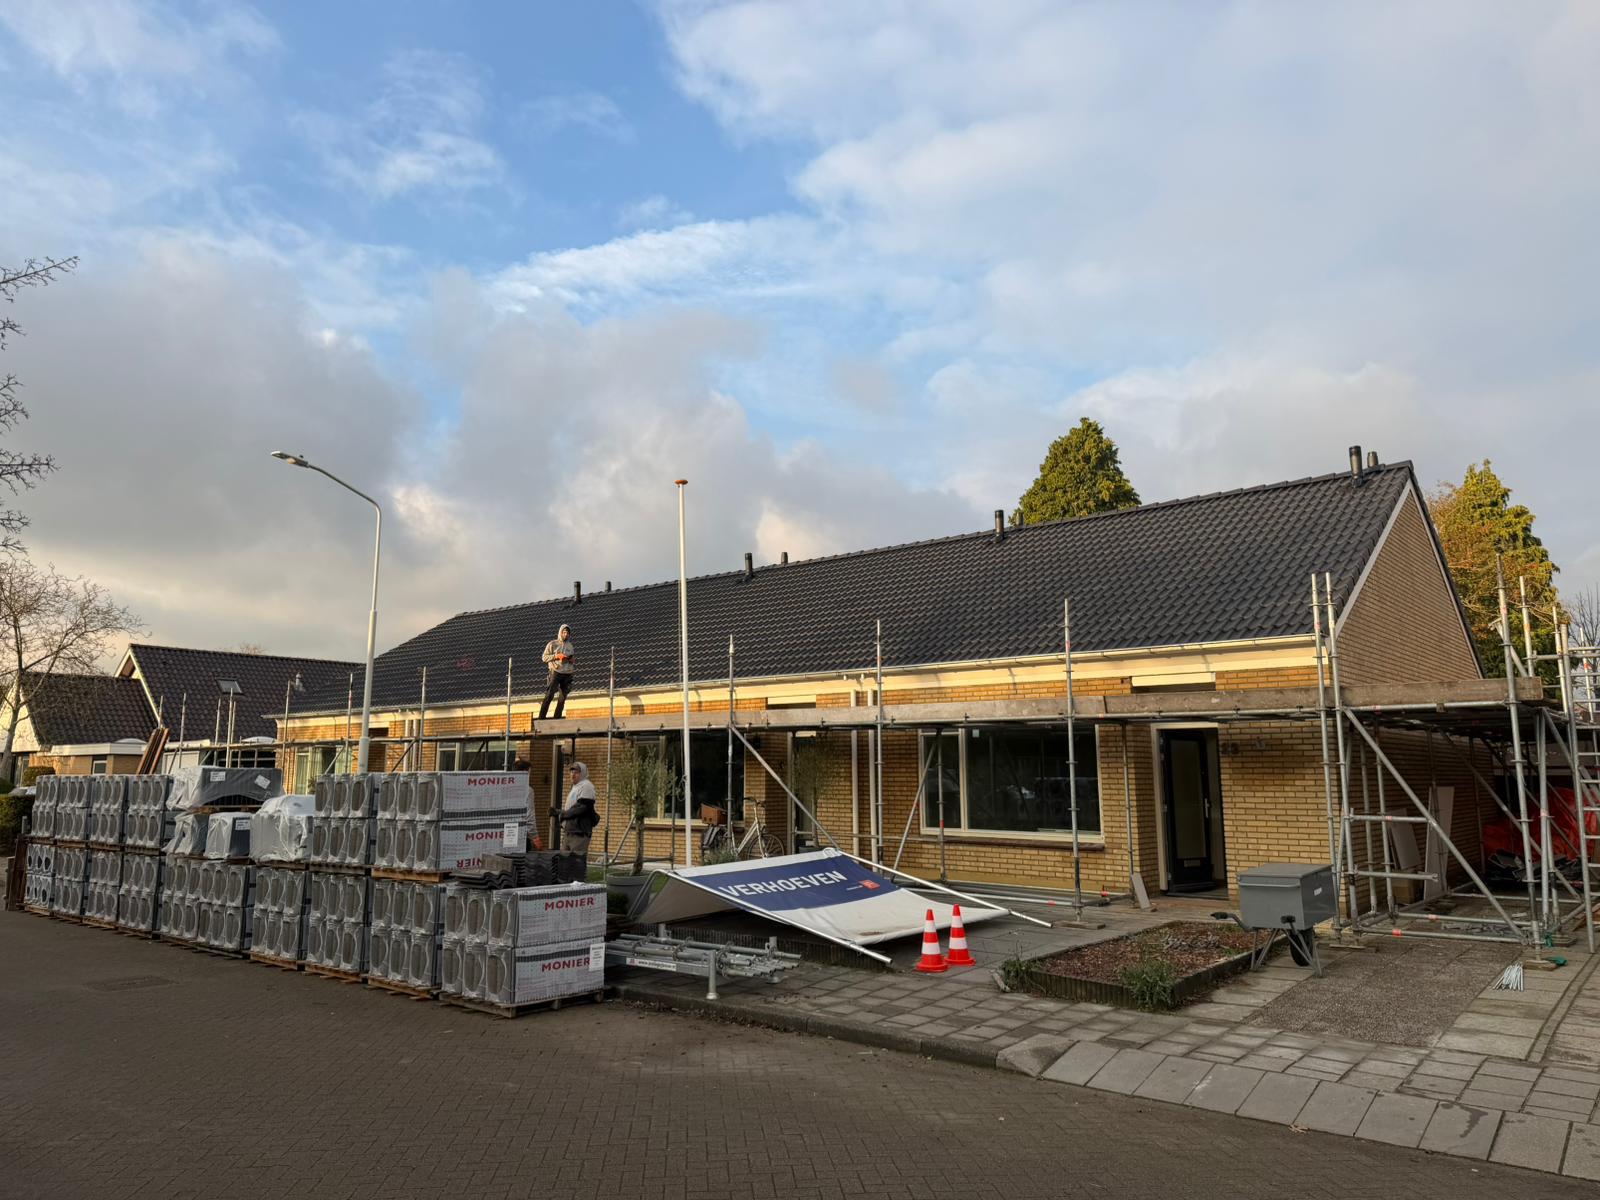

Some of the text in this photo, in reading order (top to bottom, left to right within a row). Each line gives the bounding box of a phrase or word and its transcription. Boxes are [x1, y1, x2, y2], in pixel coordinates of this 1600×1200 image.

[467, 777, 515, 786] MONIER
[465, 831, 504, 841] MONIE
[718, 870, 847, 897] VERHOEVEN
[544, 897, 594, 911] MONIER
[541, 957, 590, 972] MONIER
